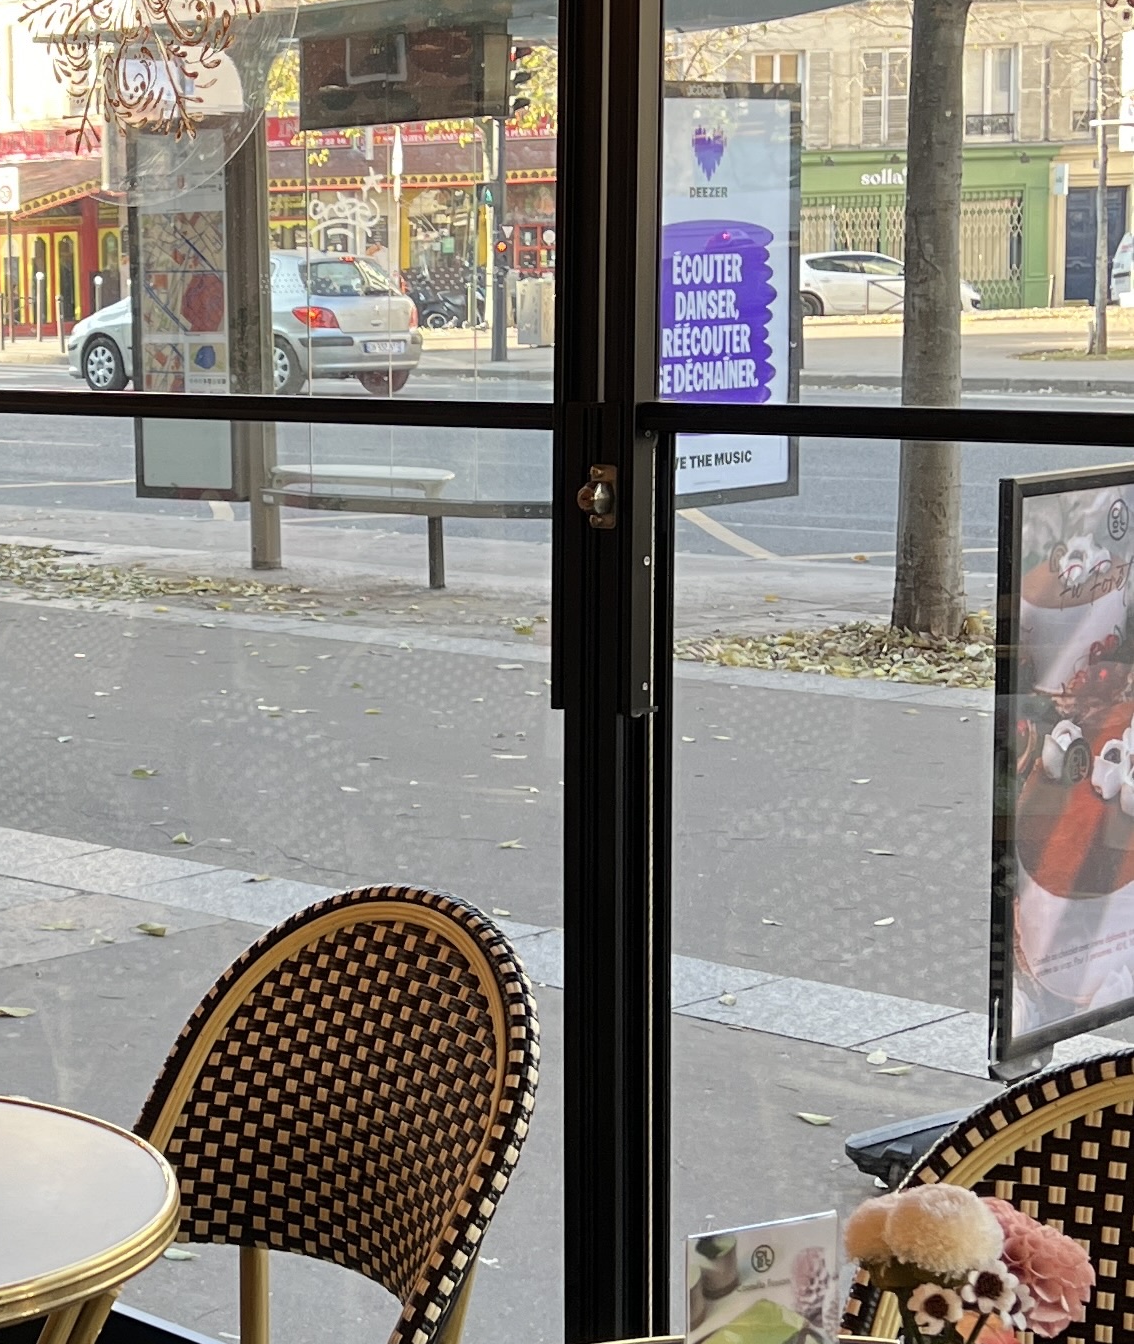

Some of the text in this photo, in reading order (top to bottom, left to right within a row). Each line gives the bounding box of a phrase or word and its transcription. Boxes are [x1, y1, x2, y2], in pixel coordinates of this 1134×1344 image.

[689, 186, 728, 198] DEEZER
[672, 251, 743, 285] ÉCOUTER
[674, 288, 739, 321] DANSER,
[662, 323, 751, 358] RÉÉCOUTER
[673, 356, 759, 394] DÉCHAÎNER.
[689, 454, 712, 469] THE
[714, 450, 752, 466] MUSIC
